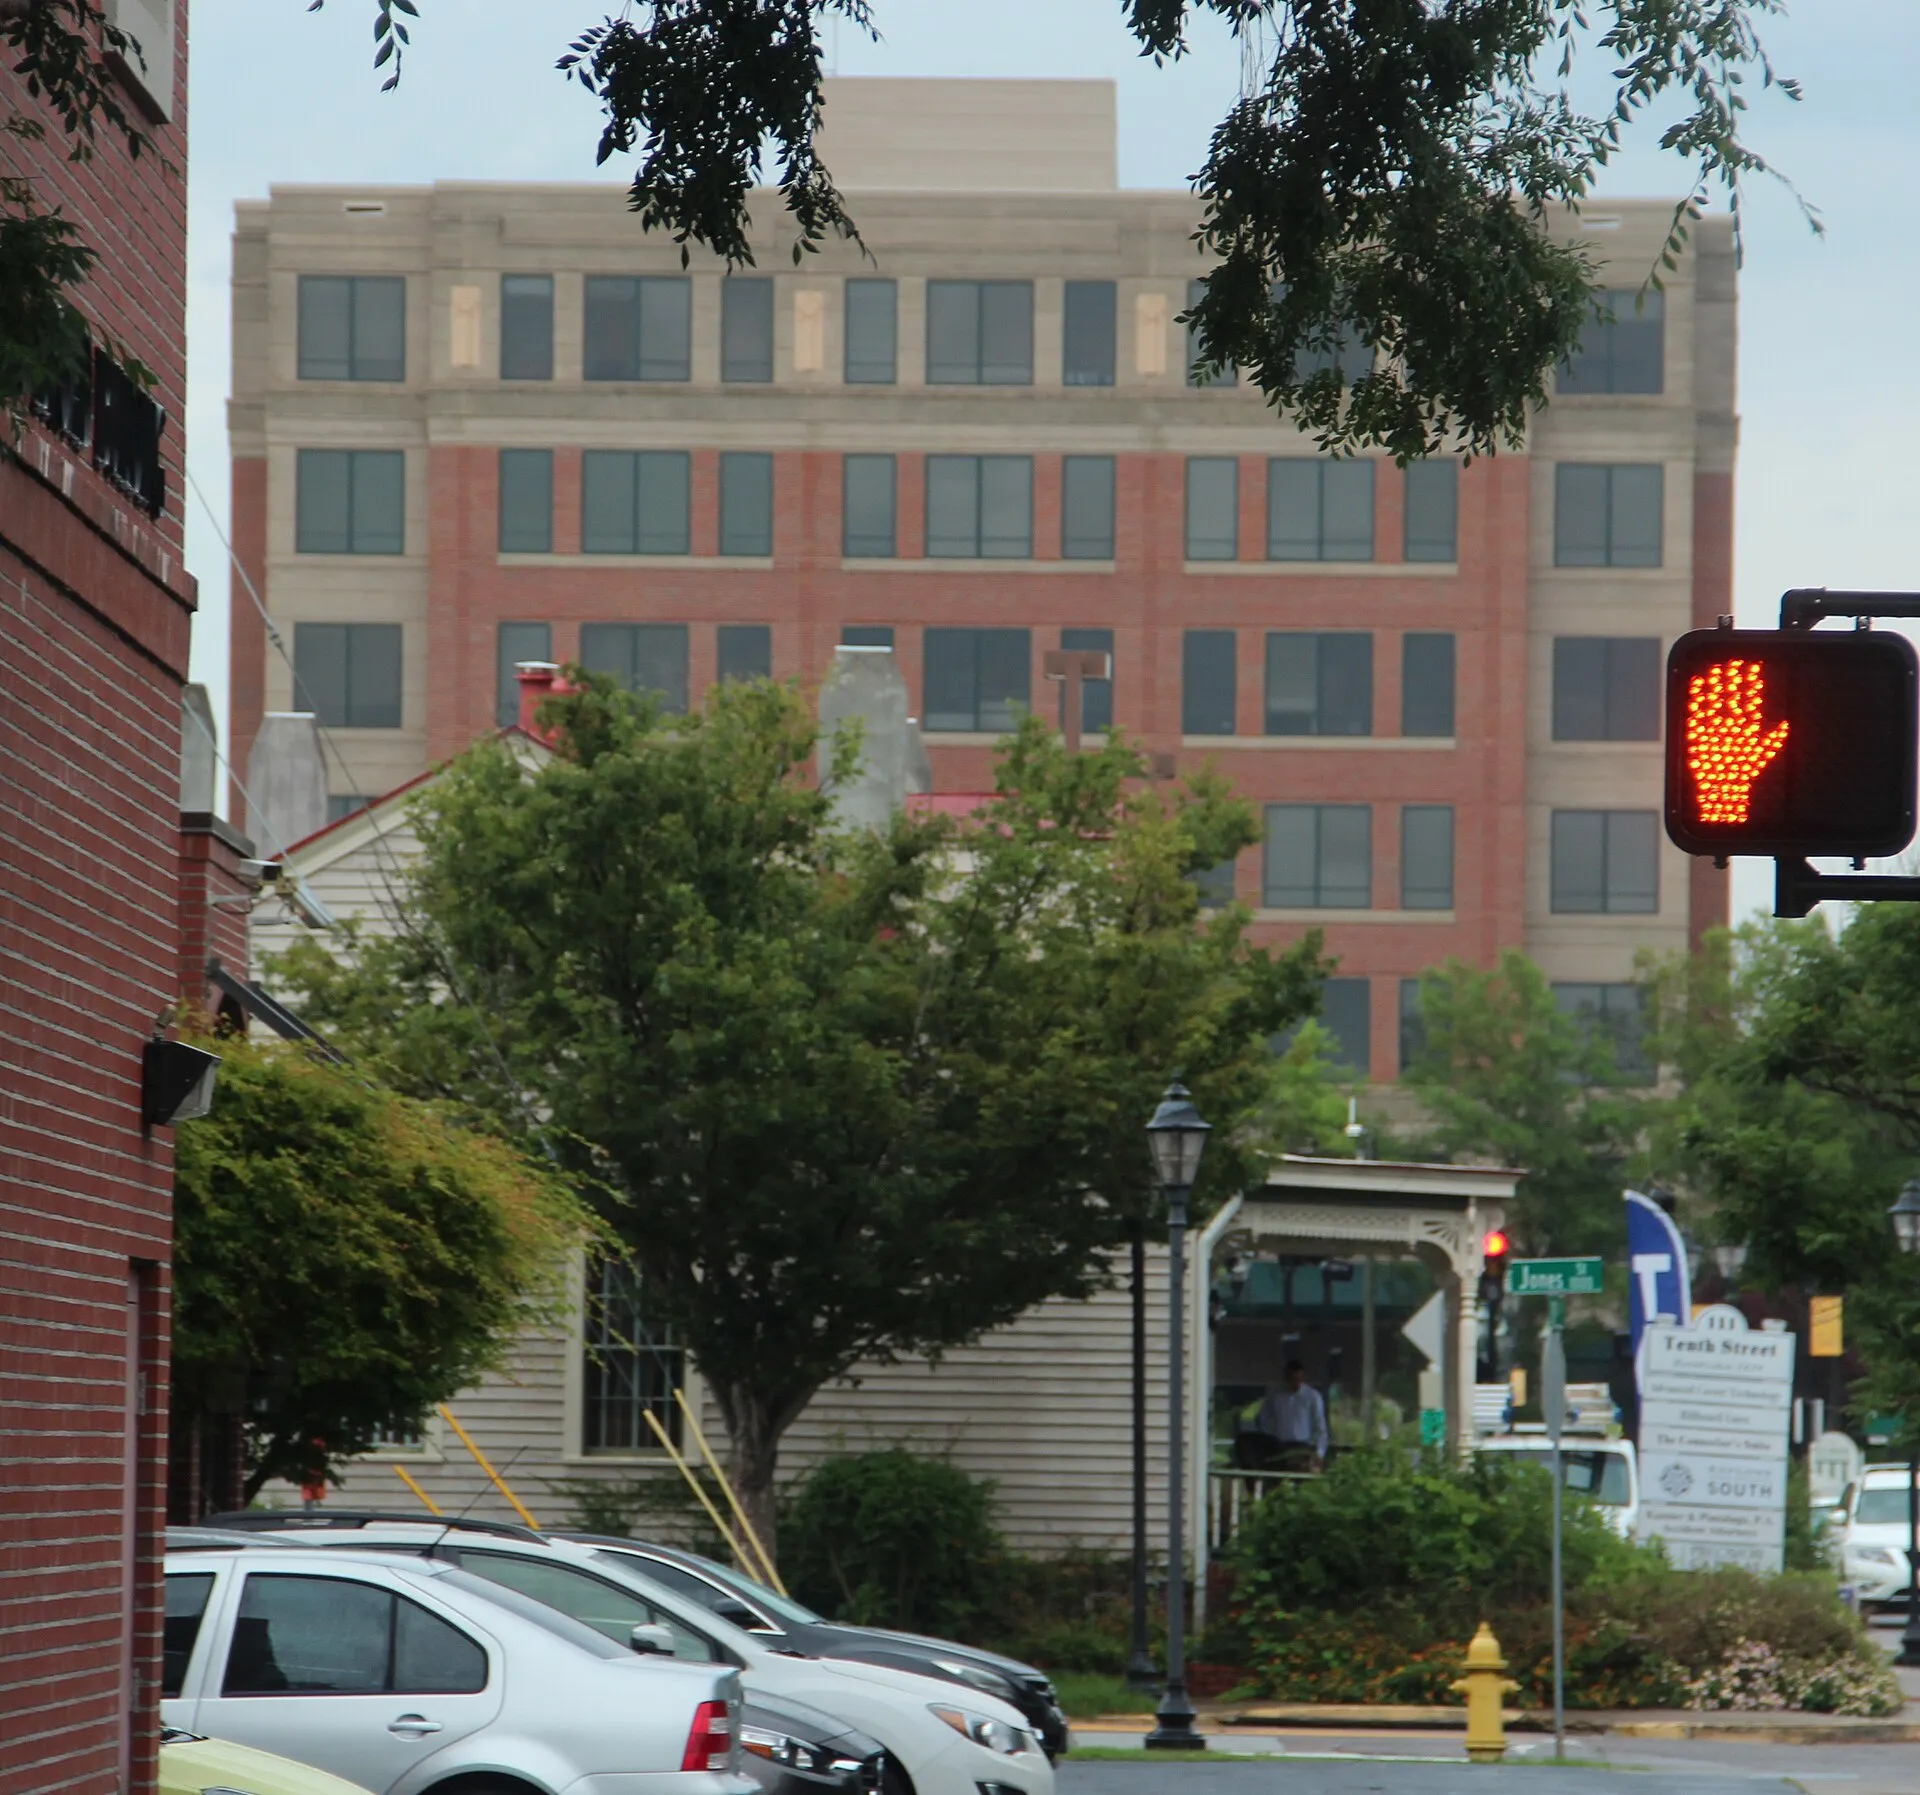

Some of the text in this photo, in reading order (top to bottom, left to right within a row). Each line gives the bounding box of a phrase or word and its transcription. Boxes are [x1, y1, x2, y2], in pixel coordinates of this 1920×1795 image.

[1518, 1265, 1564, 1290] Jones
[1631, 1253, 1672, 1321] T
[1708, 1316, 1735, 1331] 111
[1664, 1335, 1777, 1358] Tenth Street
[1657, 1434, 1676, 1445] The
[1707, 1481, 1773, 1498] SOUTH
